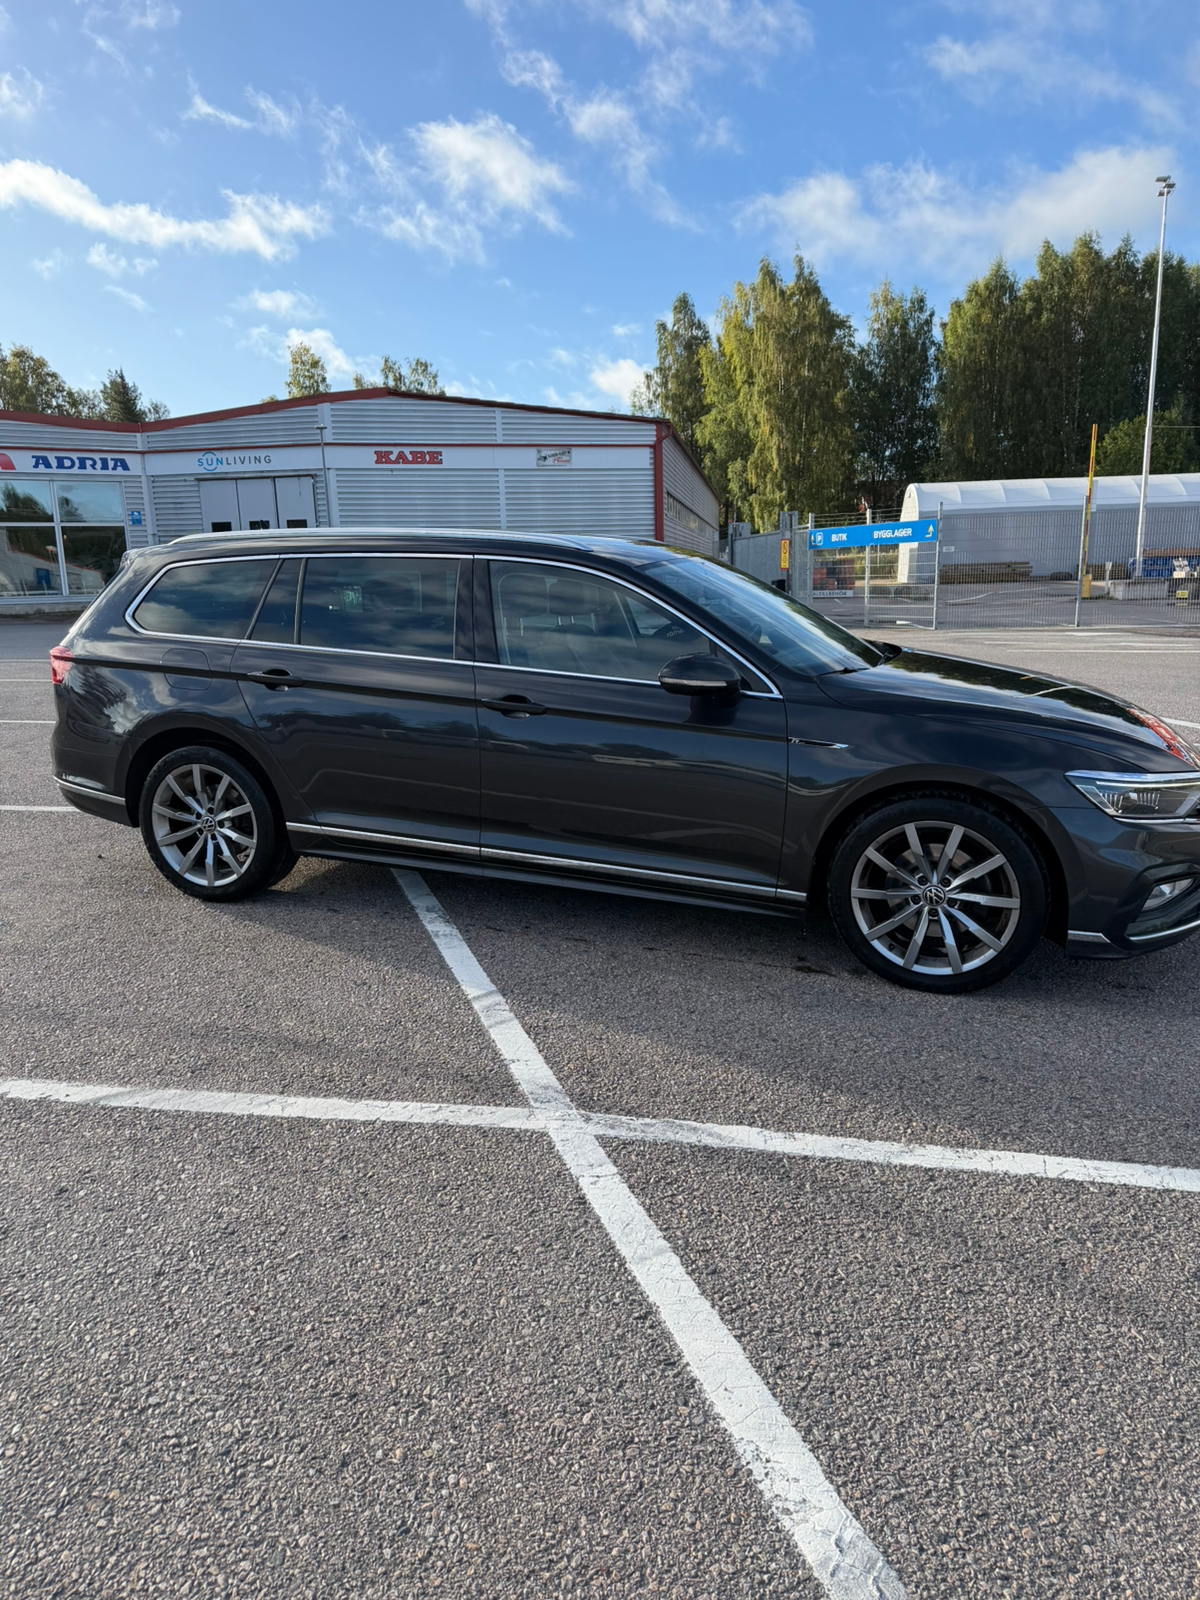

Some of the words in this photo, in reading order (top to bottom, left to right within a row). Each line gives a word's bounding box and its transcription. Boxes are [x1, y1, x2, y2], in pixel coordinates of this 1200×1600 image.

[31, 455, 131, 471] ADRIA
[197, 454, 272, 468] SUNLIVING
[374, 450, 443, 465] KABE
[831, 533, 848, 542] BUTIK
[873, 527, 912, 539] BYGGLAGER
